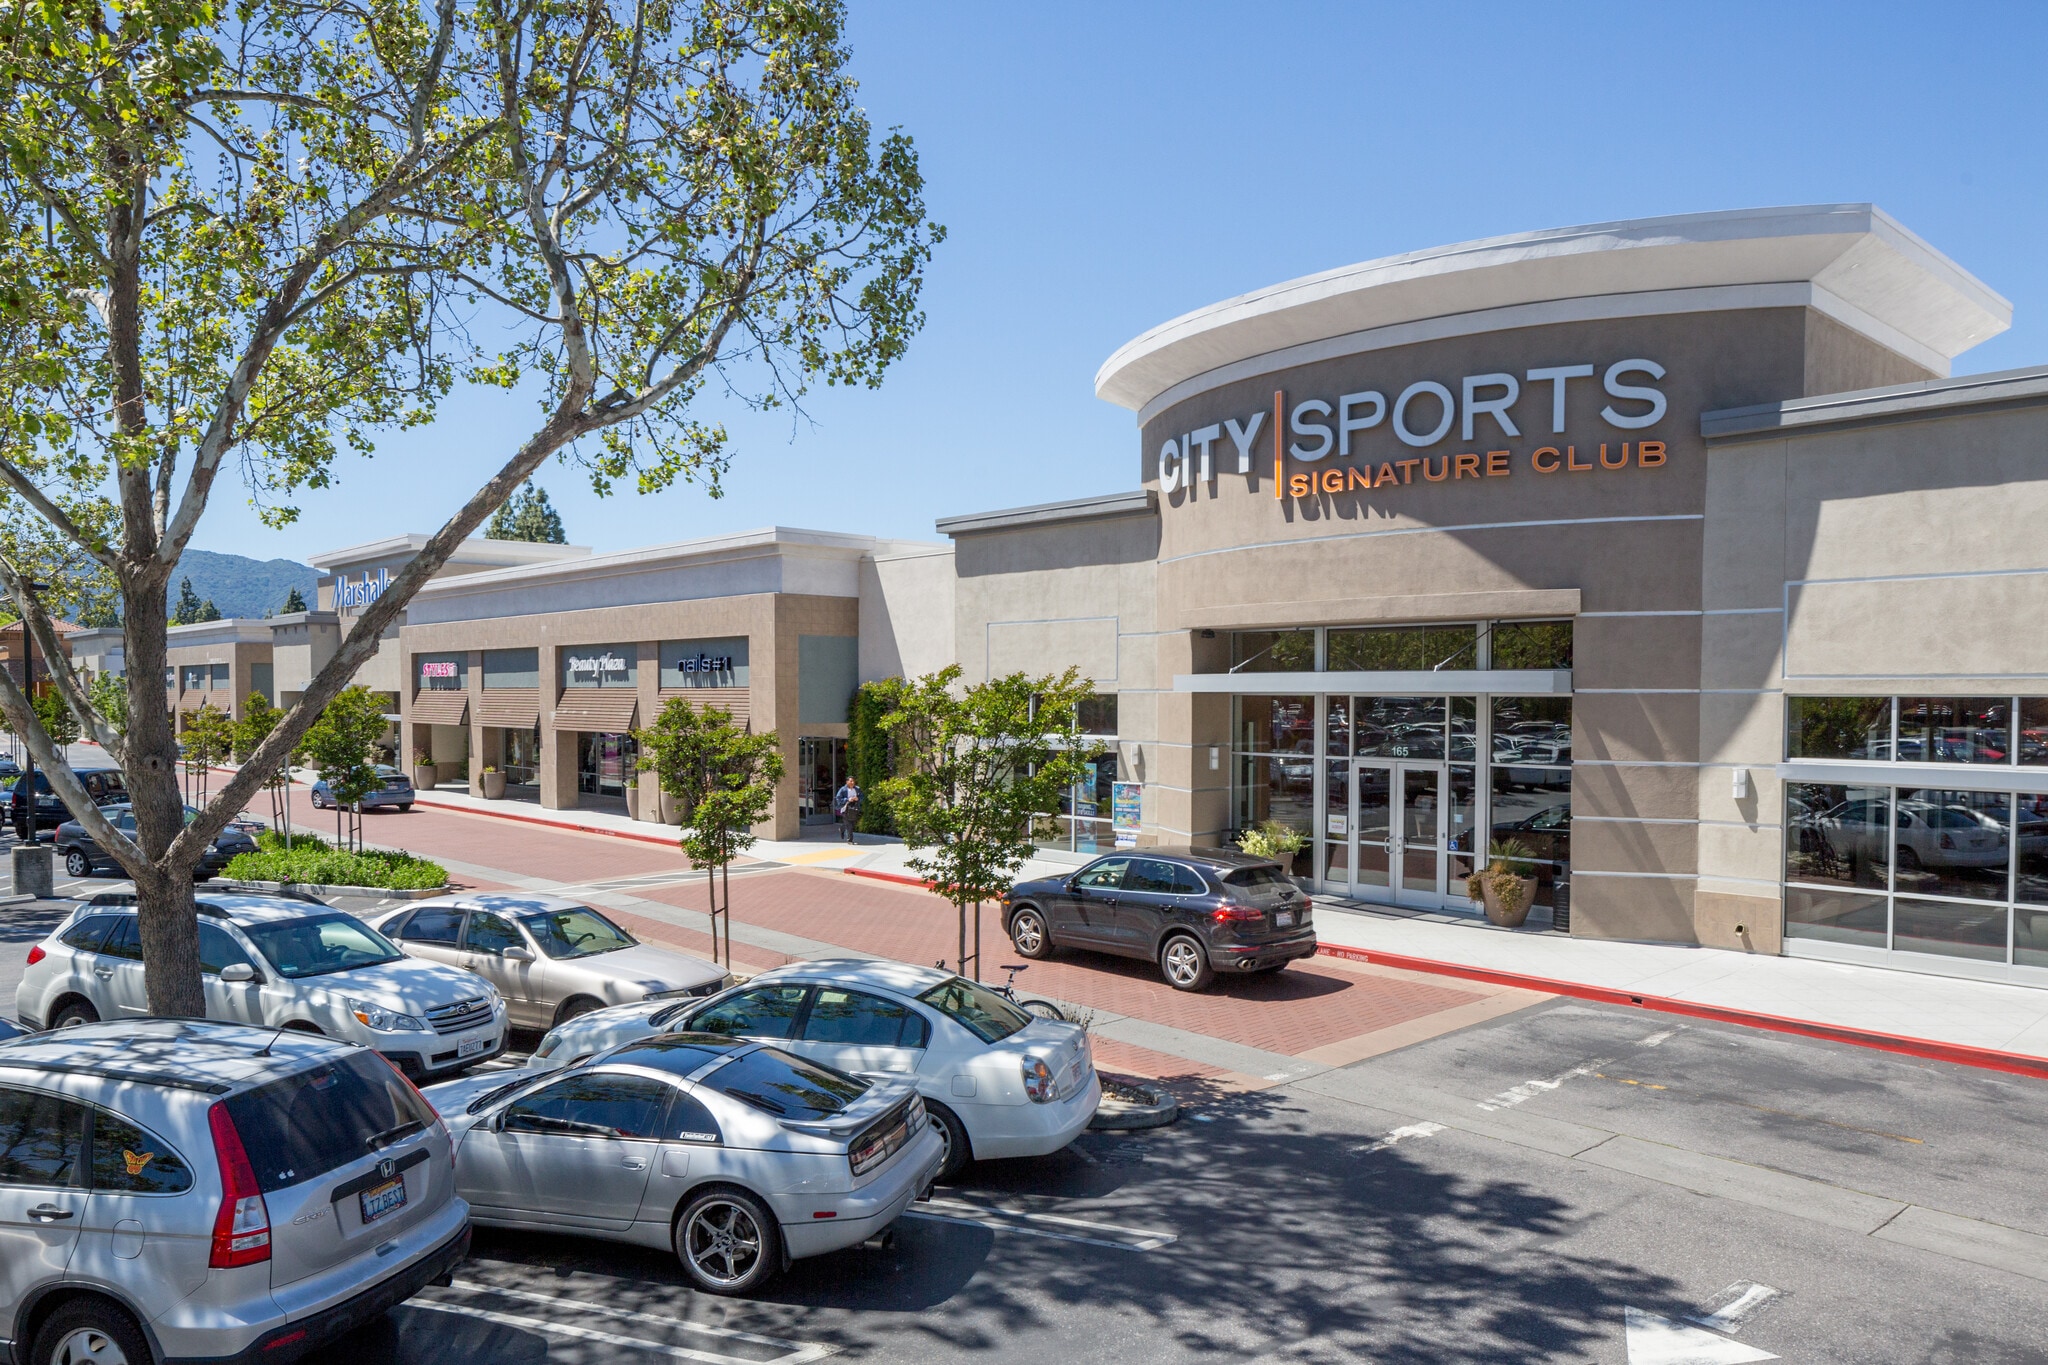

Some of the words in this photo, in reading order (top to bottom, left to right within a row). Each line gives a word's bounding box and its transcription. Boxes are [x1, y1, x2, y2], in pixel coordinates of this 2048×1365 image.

[1159, 411, 1266, 494] CITY
[1289, 358, 1668, 463] SPORTS
[1289, 450, 1510, 498] SIGNATURE
[1531, 440, 1668, 474] CLUB
[569, 656, 600, 678] Beauty
[600, 652, 627, 671] Plaza
[677, 653, 730, 673] nails#1
[1391, 746, 1409, 757] 165
[1316, 947, 1331, 956] LANE
[1336, 950, 1345, 958] NO
[1345, 952, 1369, 963] PARKING
